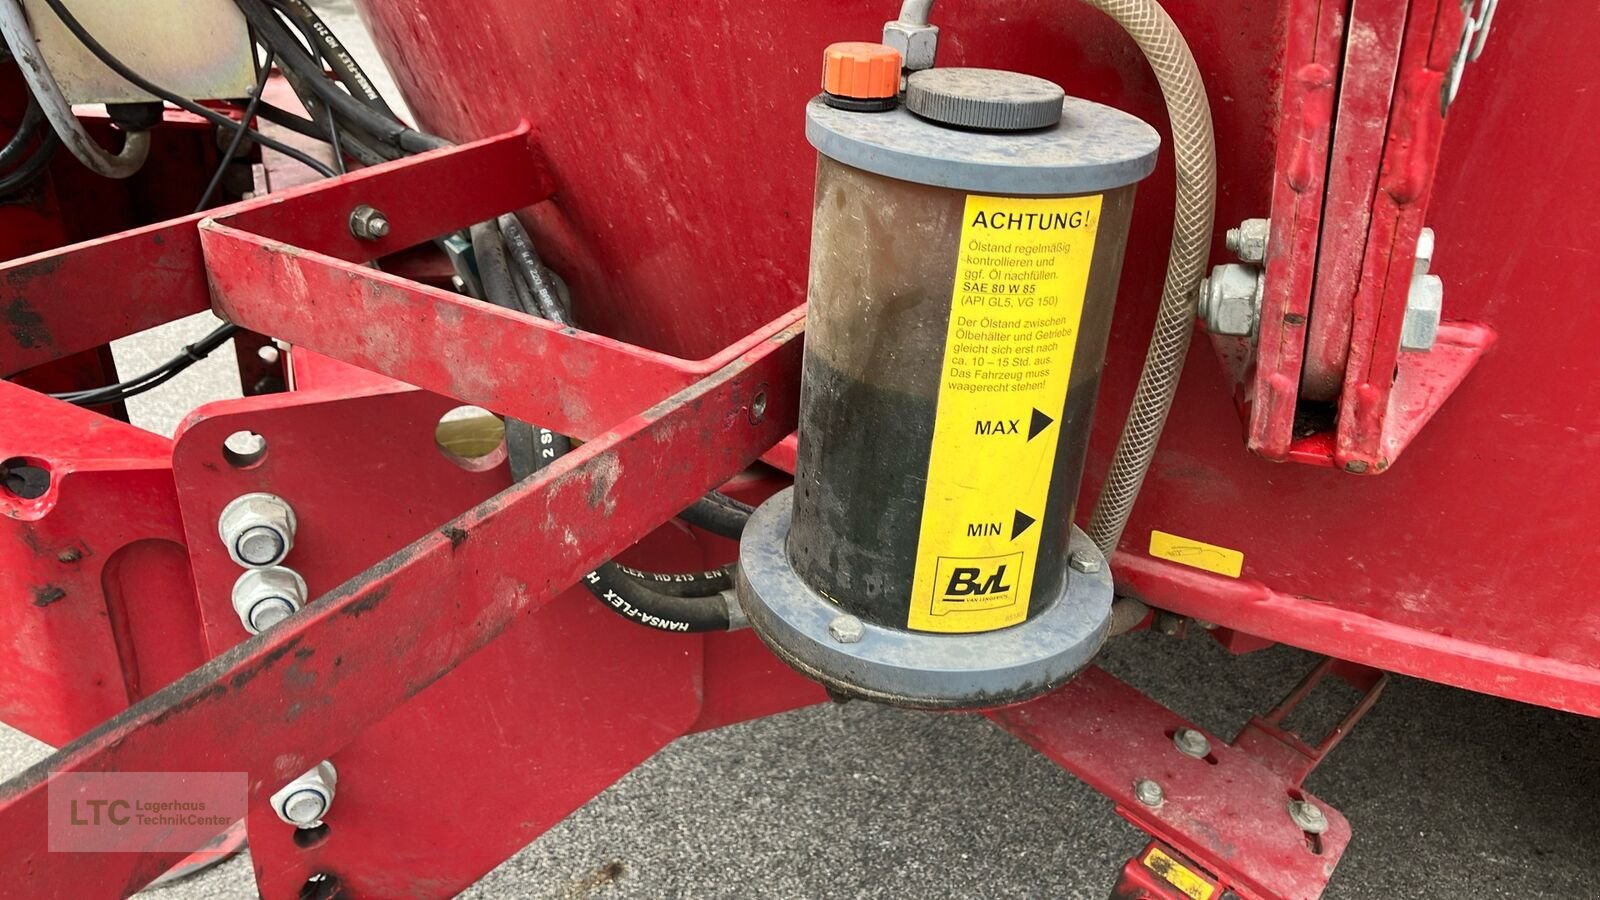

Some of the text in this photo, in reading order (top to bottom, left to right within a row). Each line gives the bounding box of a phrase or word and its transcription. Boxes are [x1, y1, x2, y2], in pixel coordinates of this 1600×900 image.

[971, 210, 1091, 230] ACHTUNG!
[968, 240, 1071, 256] Ölstand regelmäßig
[966, 255, 1055, 267] kontrollieren und
[964, 268, 1059, 281] ggf. Öl nachfüllen.
[529, 270, 542, 285] 220
[540, 288, 554, 308] BAR
[963, 282, 1036, 294] SAE 80 W 85
[961, 295, 1059, 308] (API GL5, VG 150)
[957, 316, 1066, 329] Der Ölstand zwischen
[955, 328, 1072, 342] Ölbehälter und Getriebe
[953, 342, 1058, 355] gleicht sich erst nach
[951, 357, 967, 366] ca.
[972, 357, 984, 367] 10
[998, 357, 1009, 367] 15
[1012, 356, 1031, 367] Std.
[1033, 356, 1053, 366] aus.
[950, 367, 1050, 381] Das Fahrzeug muss
[948, 379, 1046, 394] waagerecht stehen!
[975, 419, 1020, 436] MAX
[542, 447, 554, 459] 2
[967, 522, 1002, 537] MIN
[653, 573, 671, 582] HD
[675, 573, 695, 582] 213
[703, 569, 721, 580] EN
[944, 564, 1011, 595] BvL
[603, 588, 690, 632] HANSA-FLEX
